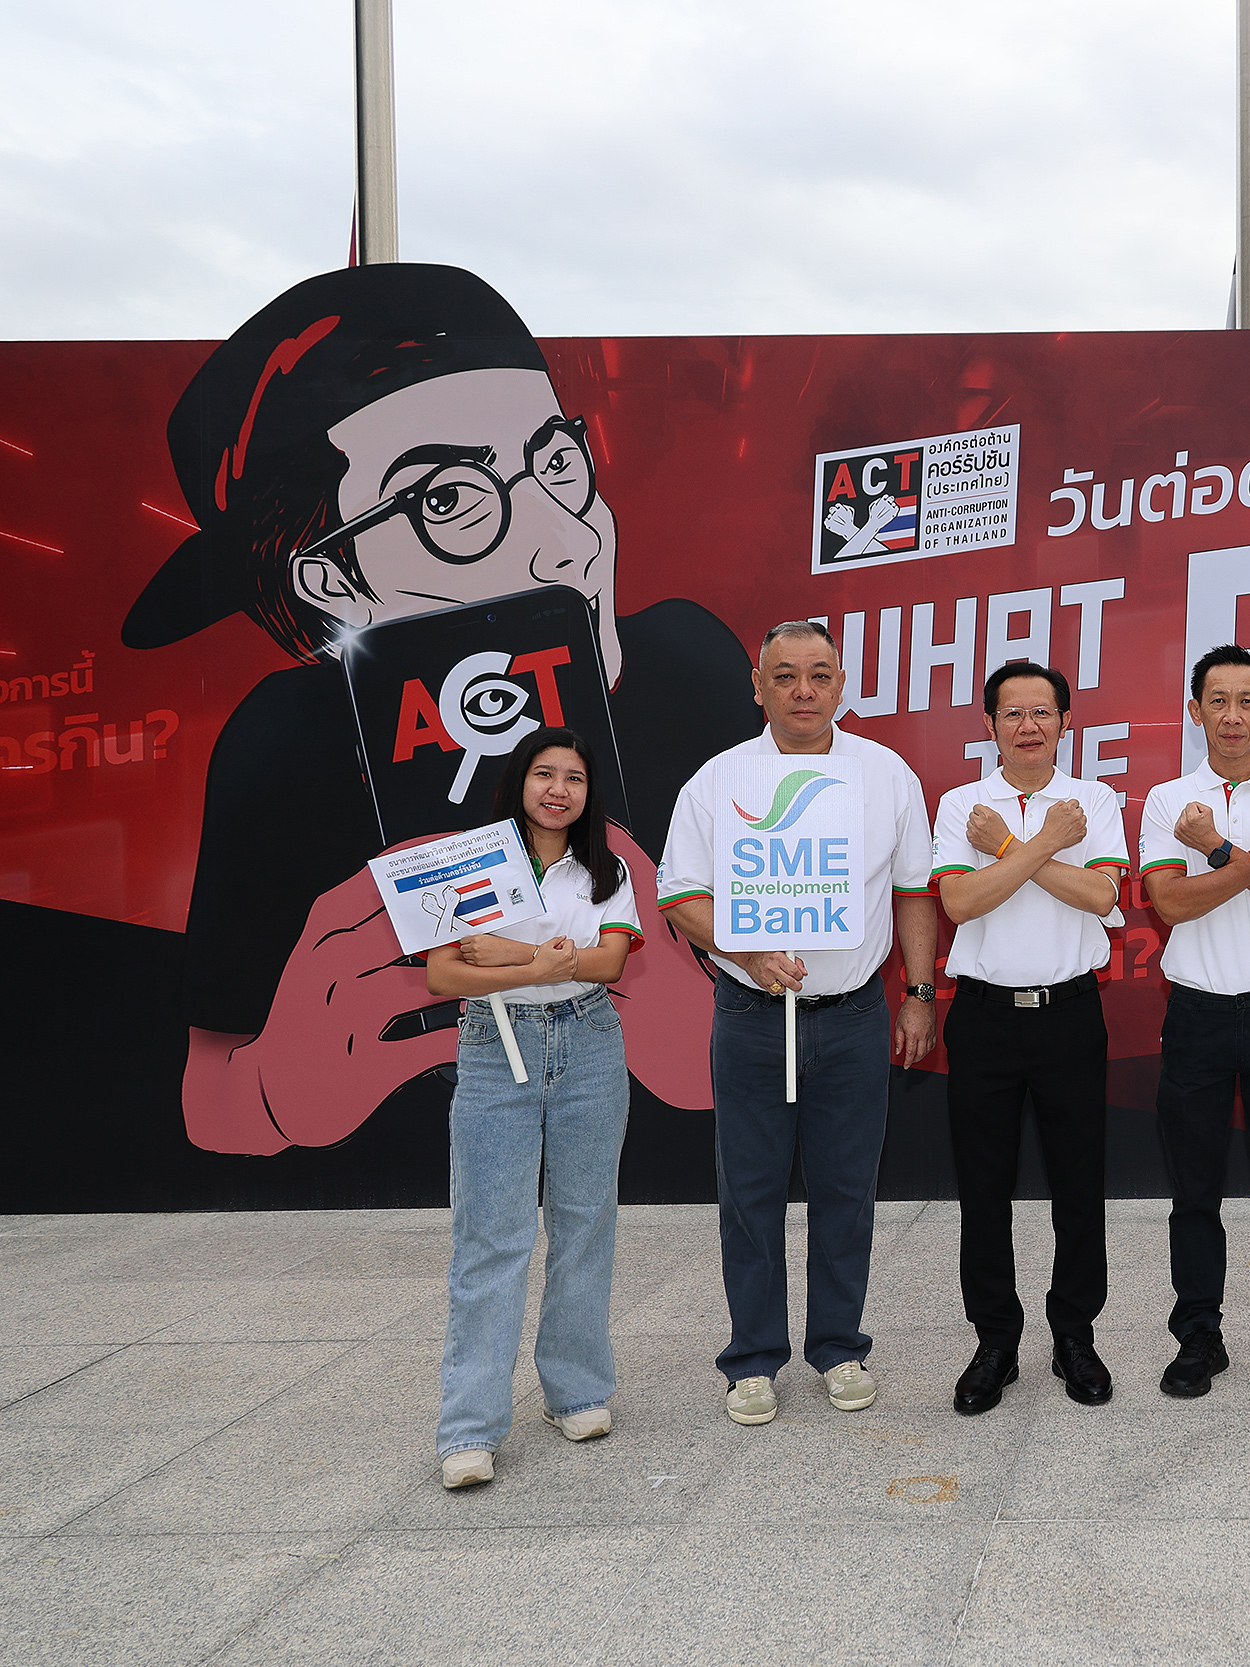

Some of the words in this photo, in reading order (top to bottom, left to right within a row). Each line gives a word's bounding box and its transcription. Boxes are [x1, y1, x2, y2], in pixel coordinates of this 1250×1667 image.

[928, 431, 1012, 455] องค์กรต่อต้าน
[826, 451, 920, 502] ACT
[927, 450, 1011, 479] คอร์รัปชัน
[926, 471, 1010, 498] (ประเทศไทย)
[925, 498, 1009, 520] ANTI-CORRUPTION
[924, 514, 1008, 535] ORGANIZATION
[924, 536, 940, 550] OF
[945, 528, 1008, 547] THAILAND
[392, 645, 572, 804] ACT
[730, 836, 850, 878] SME
[730, 880, 850, 897] Development
[730, 897, 850, 935] Bank
